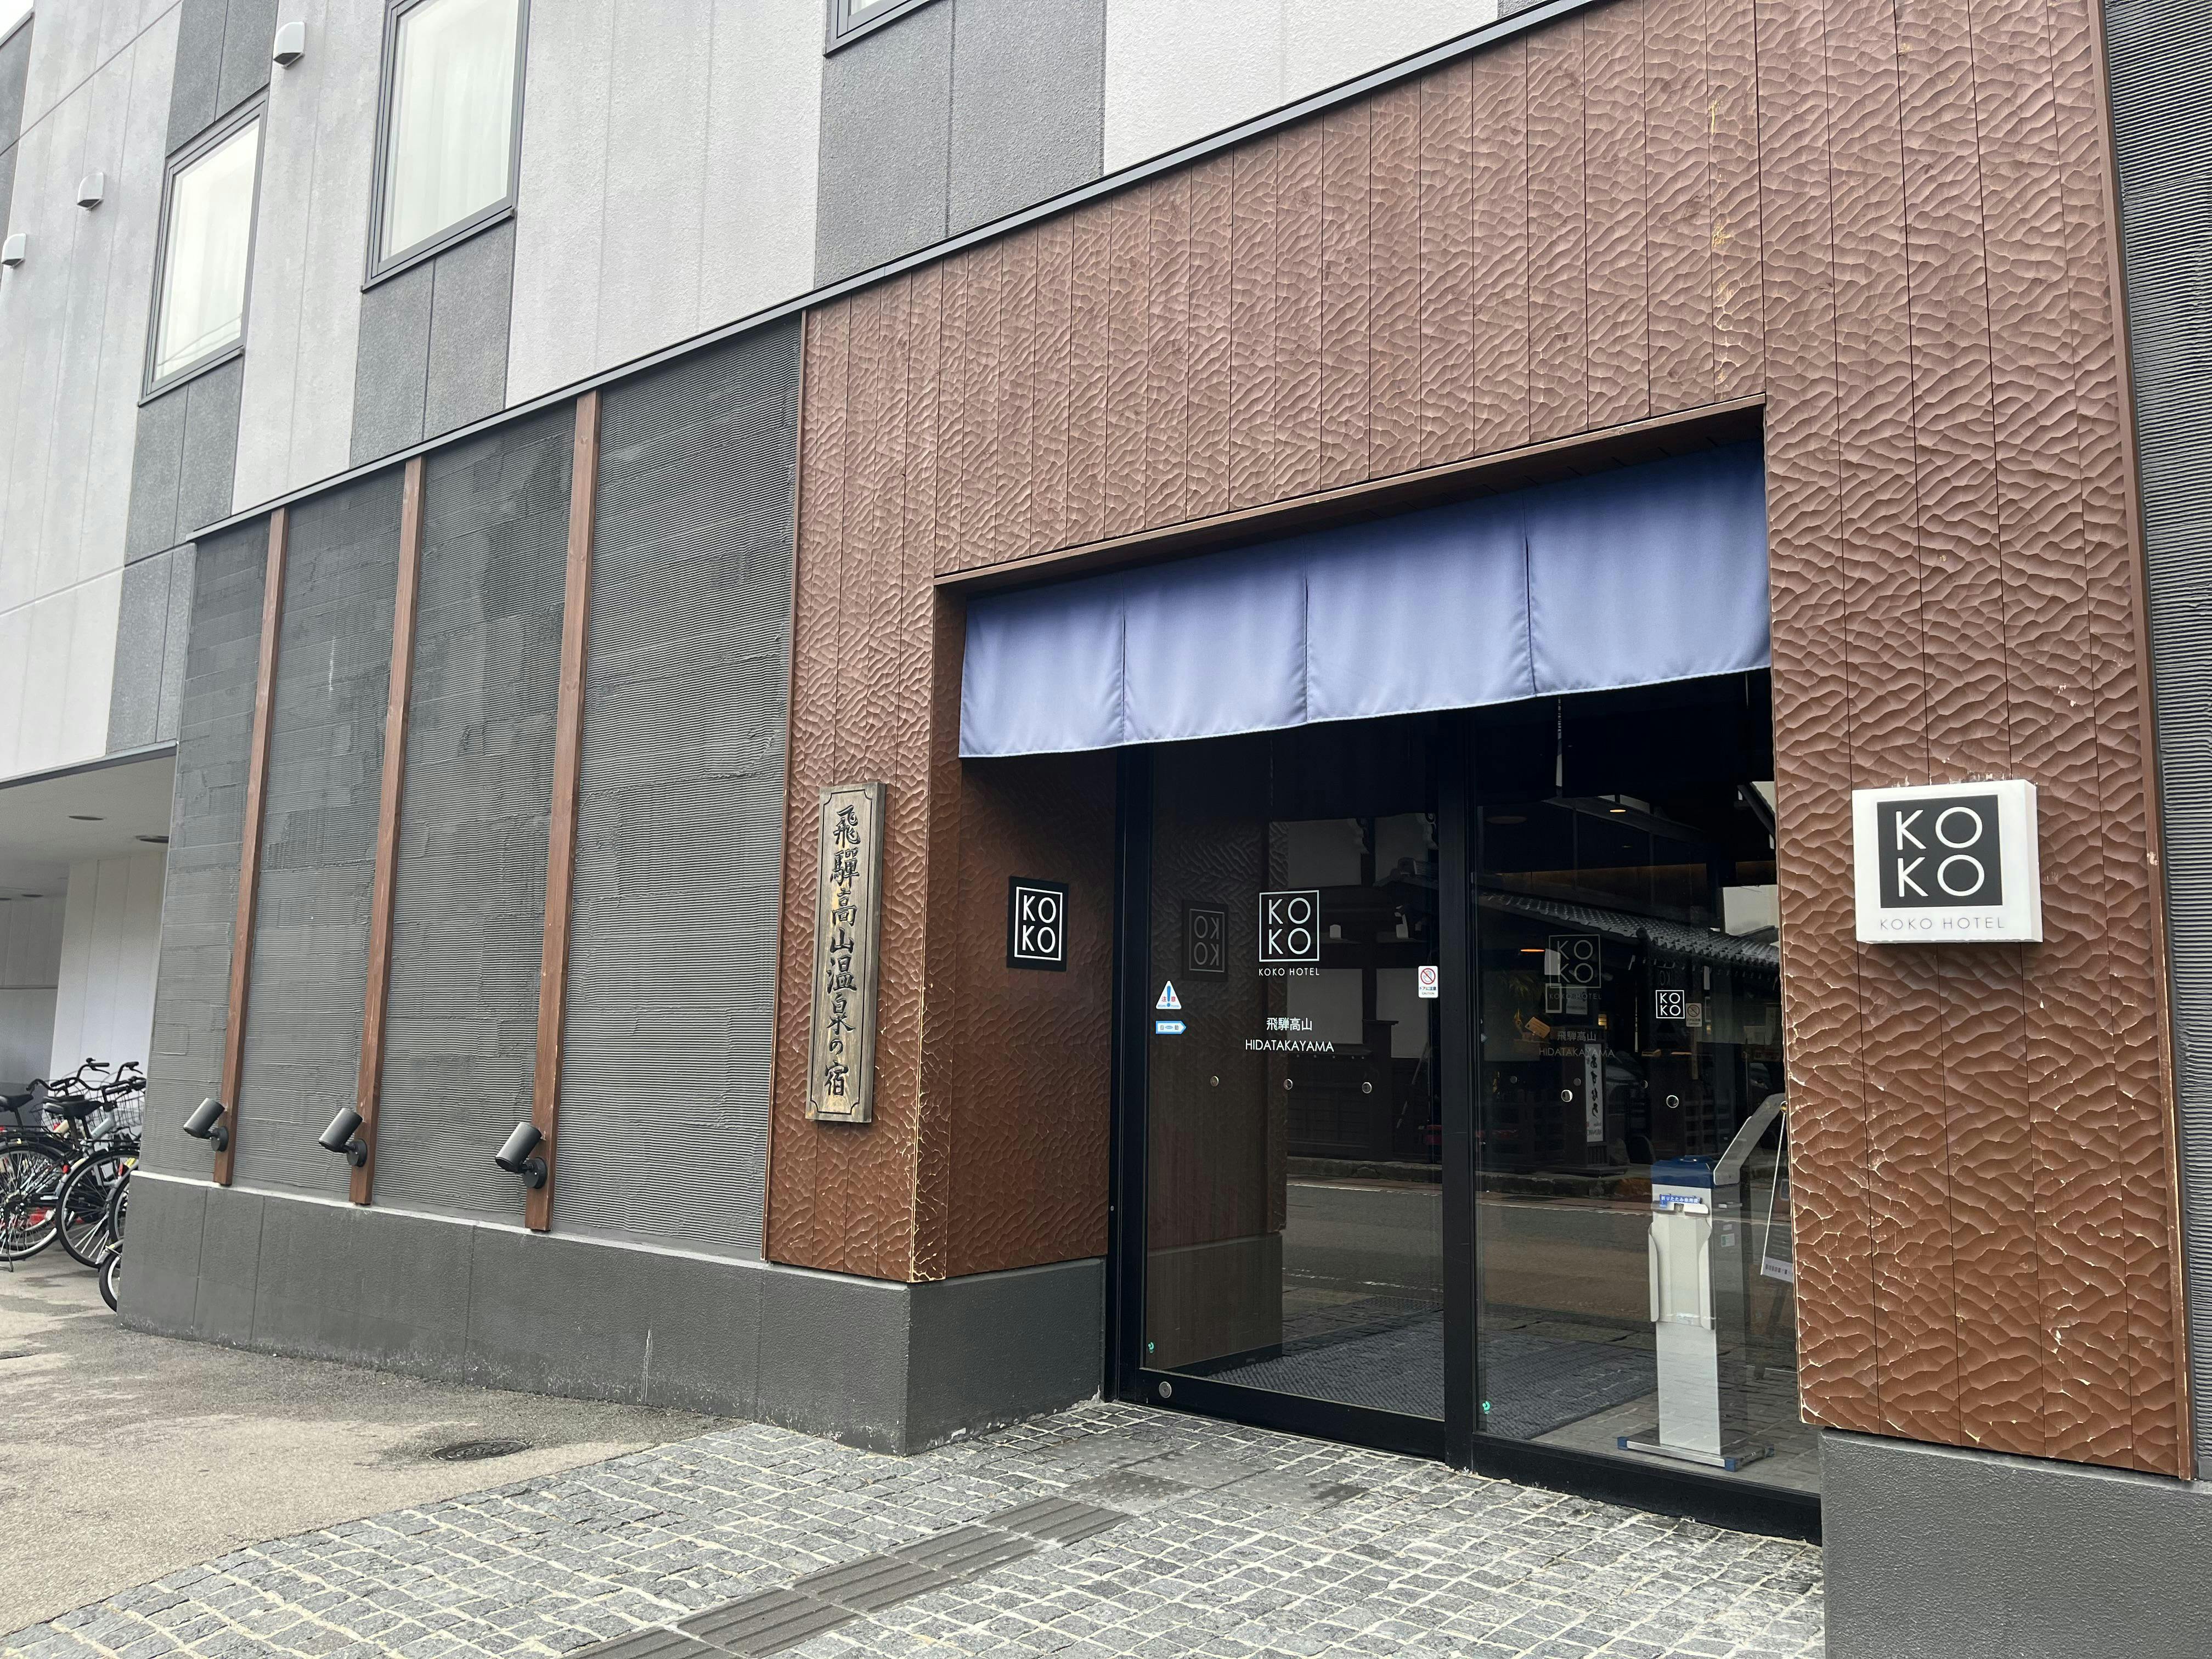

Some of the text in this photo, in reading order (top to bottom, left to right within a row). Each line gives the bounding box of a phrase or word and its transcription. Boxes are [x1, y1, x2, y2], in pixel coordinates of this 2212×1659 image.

[1896, 806, 1983, 850] KO
[1897, 854, 1985, 897] KO
[1023, 895, 1056, 923] KO
[1269, 898, 1311, 924] KO
[1881, 917, 2005, 930] KOKO HOTEL
[1022, 925, 1056, 953] KO
[1269, 928, 1311, 955] KO
[1557, 940, 1593, 960] KO
[1259, 967, 1320, 976] KOKO HOTEL
[1558, 963, 1594, 983] KO
[1660, 992, 1680, 1003] KO
[1661, 1005, 1681, 1016] KO
[1266, 1017, 1312, 1031] 飛騨高山
[1245, 1039, 1334, 1052] HIDATAKAYAMA
[1539, 1048, 1615, 1058] HIDATAKAYAMA
